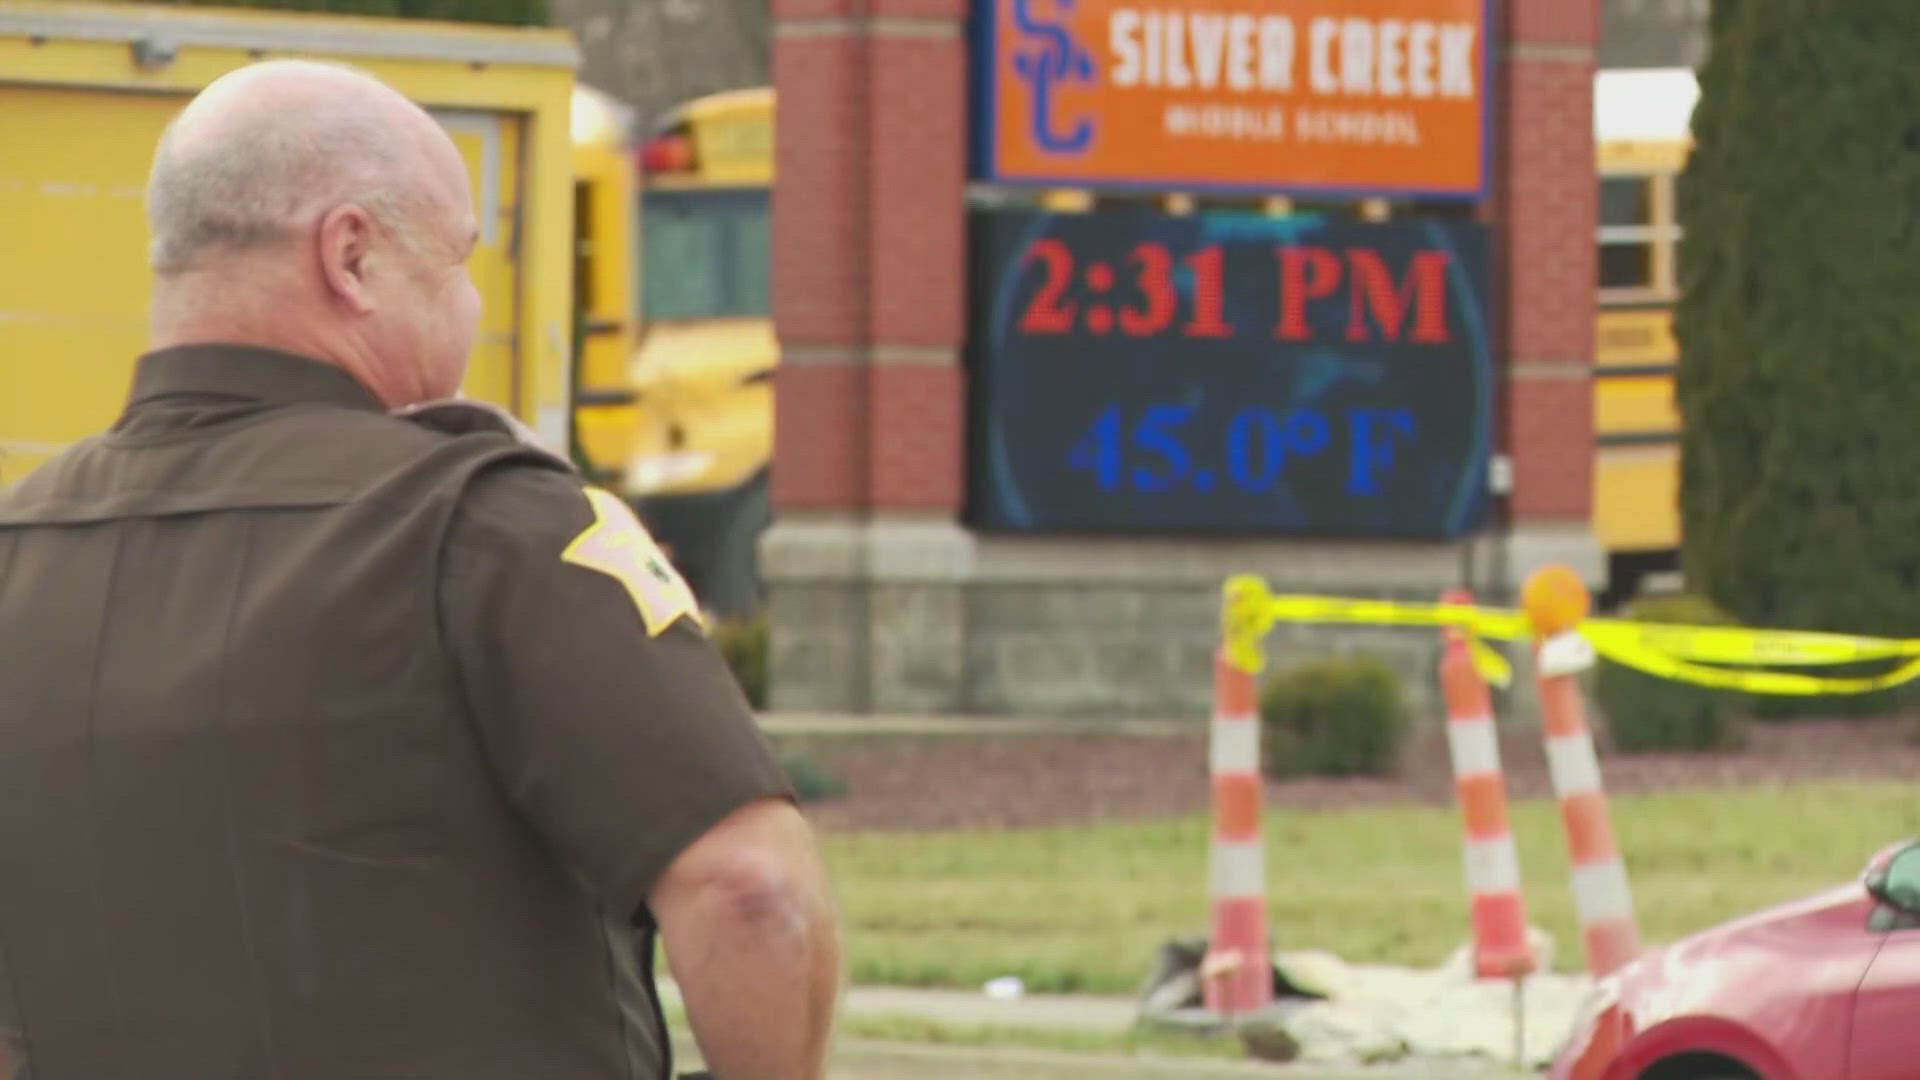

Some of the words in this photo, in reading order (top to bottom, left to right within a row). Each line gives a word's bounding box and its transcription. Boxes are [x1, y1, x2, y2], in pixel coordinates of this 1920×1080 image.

[1110, 8, 1296, 91] SILVER
[1309, 15, 1475, 98] CREEK
[1164, 103, 1284, 142] MIDDLE
[1296, 107, 1419, 145] SCHOOL
[1019, 239, 1233, 338] 2:31
[1275, 246, 1452, 343] PM
